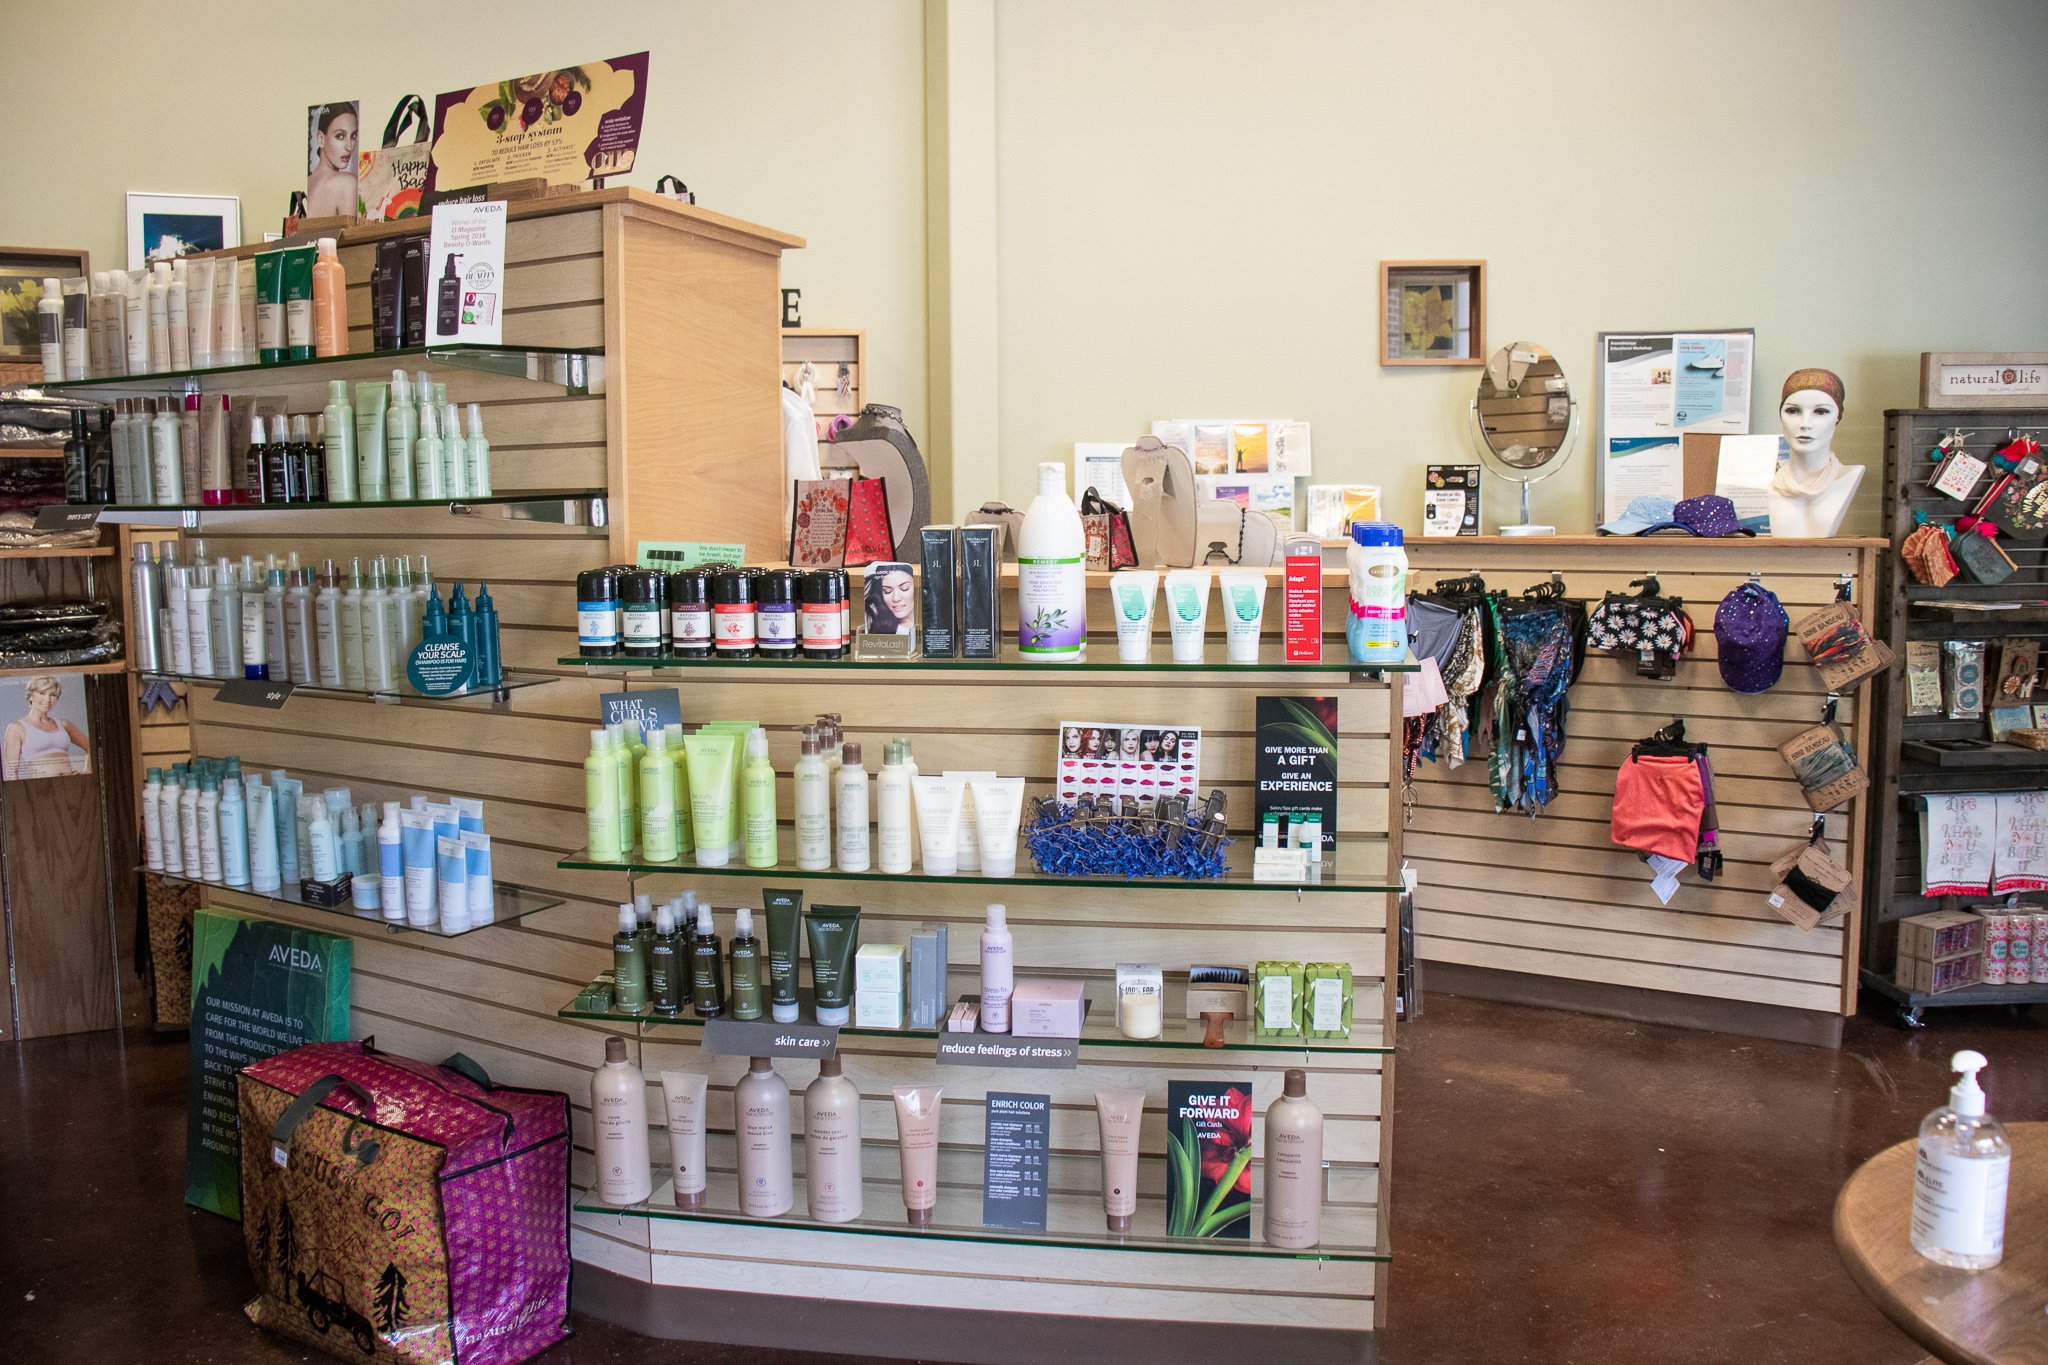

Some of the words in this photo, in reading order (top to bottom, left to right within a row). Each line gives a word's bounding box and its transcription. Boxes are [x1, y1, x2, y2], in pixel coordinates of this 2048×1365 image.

[496, 133, 525, 144] 3-step
[528, 126, 562, 142] system
[498, 146, 516, 155] REDUCE
[530, 141, 543, 149] LOSS
[460, 195, 472, 204] hair
[472, 194, 485, 202] loss
[473, 205, 502, 213] AVEDA
[781, 289, 801, 328] E
[1950, 370, 2000, 384] natural
[2018, 370, 2040, 383] life
[1803, 626, 1817, 638] BOHO
[1817, 613, 1844, 630] BANDEAU
[425, 643, 459, 652] CLEANSE
[862, 638, 903, 649] RevitaLash
[418, 651, 440, 660] YOUR
[441, 650, 466, 659] SCALP
[266, 691, 281, 700] style
[609, 699, 642, 711] WHAT
[610, 708, 658, 723] CURLS
[1791, 749, 1804, 760] BOHO
[1805, 736, 1830, 752] BANDEAU
[1277, 756, 1285, 765] A
[1289, 755, 1316, 765] GIFT
[1260, 781, 1333, 792] EXPERIENCE
[269, 944, 322, 972] AVEDA
[206, 997, 220, 1008] OUR
[222, 1000, 250, 1016] MISSION
[252, 1008, 260, 1017] AT
[262, 1011, 283, 1024] AVEDA
[285, 1017, 292, 1027] IS
[294, 1019, 303, 1030] TO
[205, 1012, 222, 1024] CARE
[224, 1017, 237, 1027] FOR
[239, 1020, 250, 1032] THE
[252, 1024, 276, 1038] WORLD
[277, 1031, 287, 1041] WE
[289, 1034, 303, 1046] LIVE
[205, 1028, 224, 1040] FROM
[226, 1034, 238, 1045] THE
[240, 1037, 276, 1054] PRODUCTS
[775, 1036, 796, 1047] skin
[798, 1038, 820, 1048] care
[205, 1044, 214, 1053] TO
[216, 1047, 228, 1058] THE
[229, 1050, 247, 1063] WAYS
[942, 1043, 975, 1055] reduce
[977, 1044, 1017, 1057] feelings
[1019, 1046, 1030, 1056] of
[1031, 1048, 1062, 1057] stress
[205, 1060, 221, 1072] BACK
[223, 1066, 232, 1075] TO
[204, 1076, 226, 1088] STRIVE
[991, 1100, 1018, 1109] ENRICH
[1019, 1101, 1044, 1111] COLOR
[1188, 1095, 1216, 1106] GIVE
[1220, 1096, 1230, 1106] IT
[203, 1107, 217, 1118] AND
[1179, 1108, 1239, 1119] FORWARD
[203, 1123, 210, 1132] IN
[212, 1125, 224, 1136] THE
[202, 1138, 230, 1154] AROUND
[363, 1194, 415, 1241] GO!
[465, 1320, 518, 1346] natural
[528, 1295, 548, 1316] life
